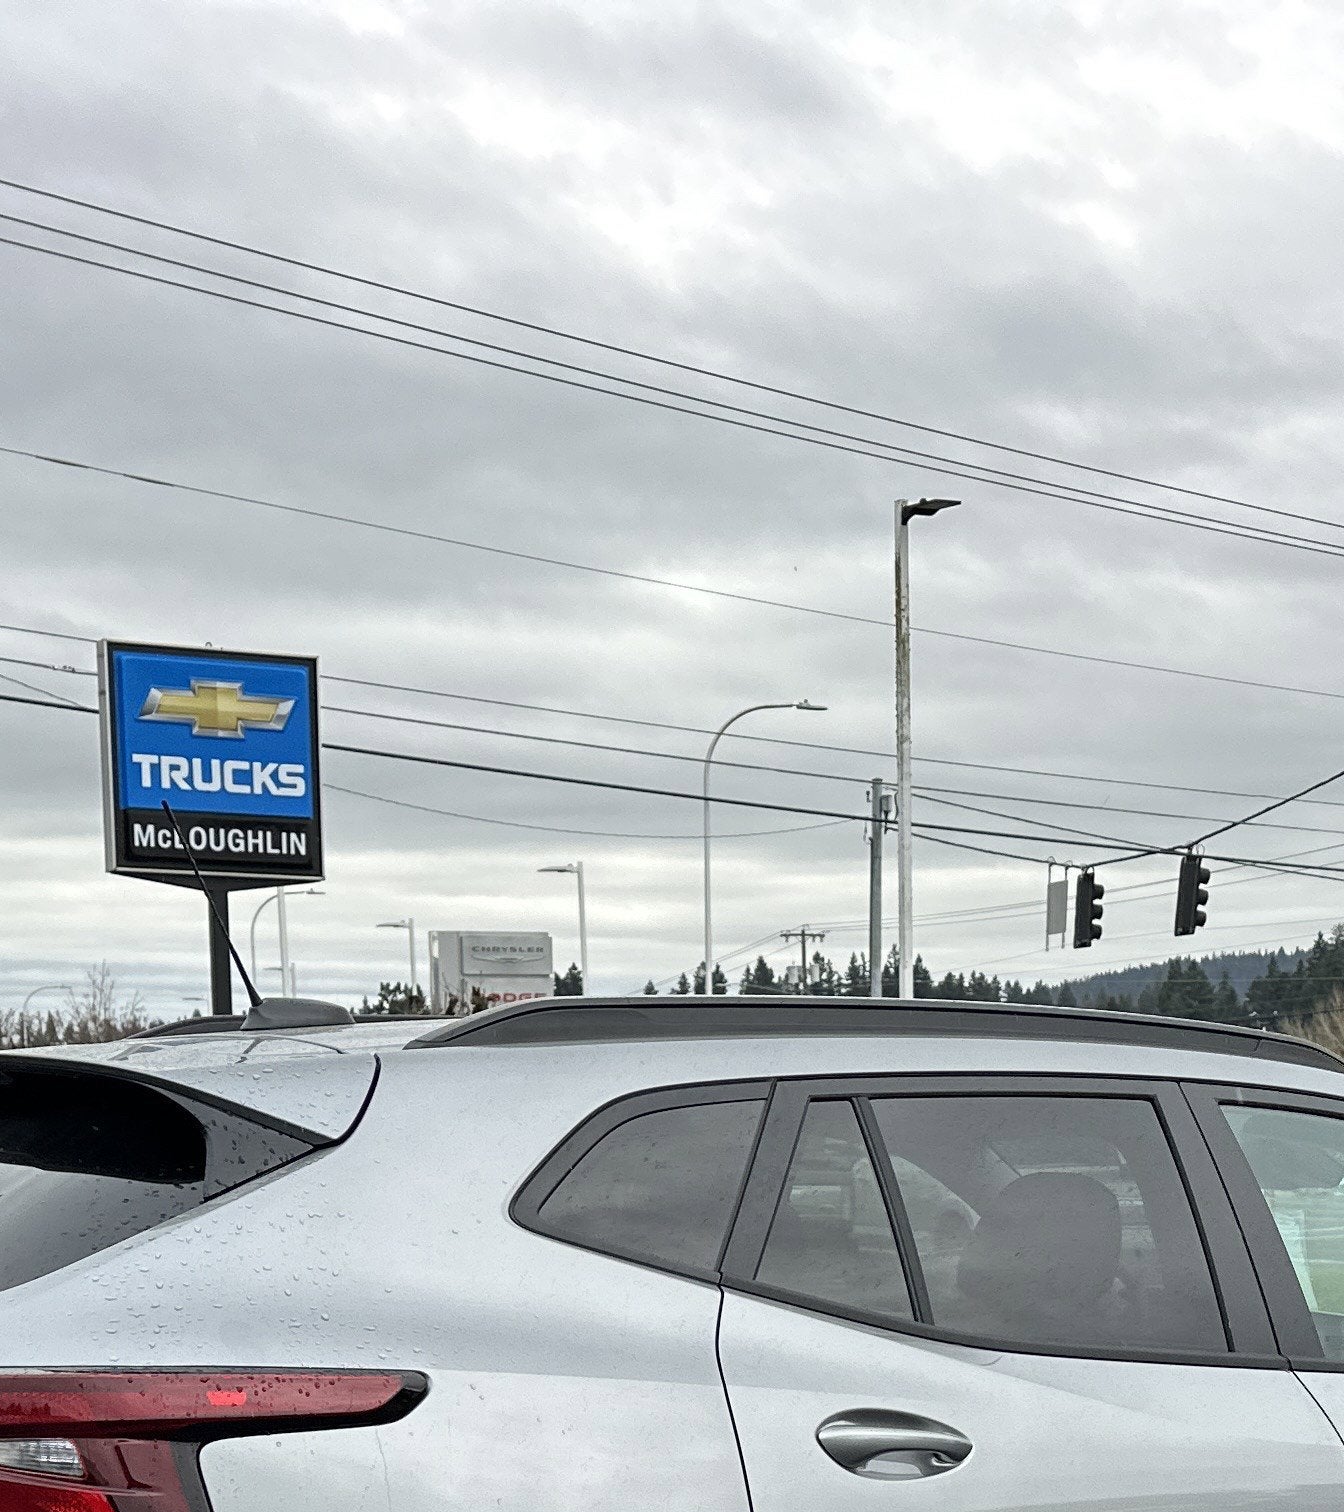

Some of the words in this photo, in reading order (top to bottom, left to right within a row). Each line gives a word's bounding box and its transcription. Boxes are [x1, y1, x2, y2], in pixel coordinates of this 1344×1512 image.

[131, 753, 306, 798] TRUCKS
[132, 822, 307, 856] McLOUGHLIN
[470, 945, 545, 953] CHRYSLER
